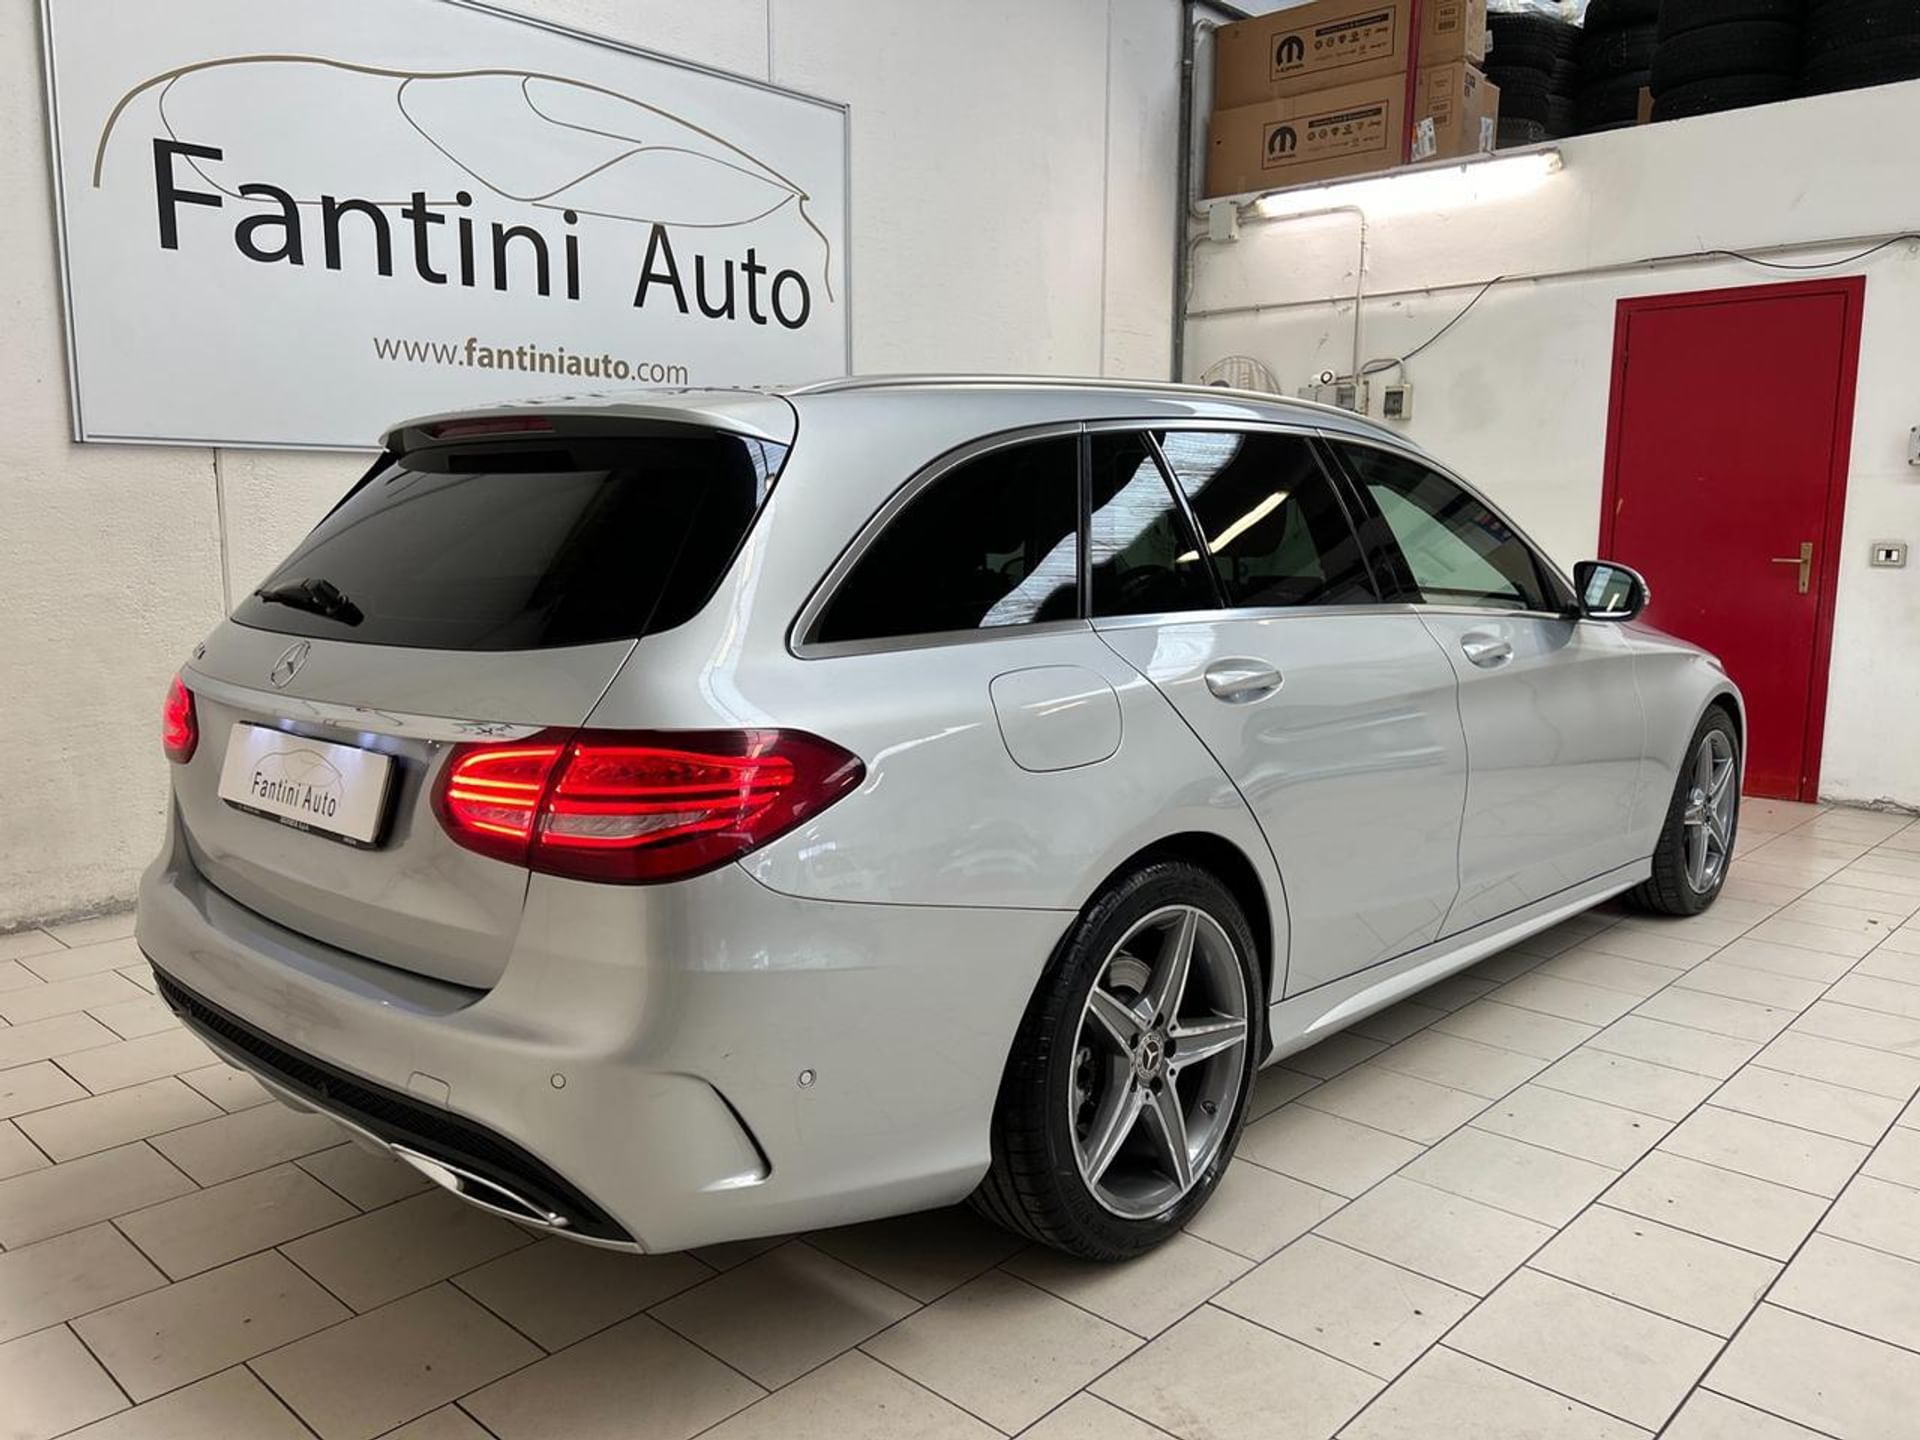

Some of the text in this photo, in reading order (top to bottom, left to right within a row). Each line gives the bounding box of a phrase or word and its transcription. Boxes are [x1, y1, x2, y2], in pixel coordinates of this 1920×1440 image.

[153, 138, 812, 330] Fantini Auto
[373, 336, 689, 386] www.fantiniauto.com
[251, 771, 337, 818] Fantini Auto
